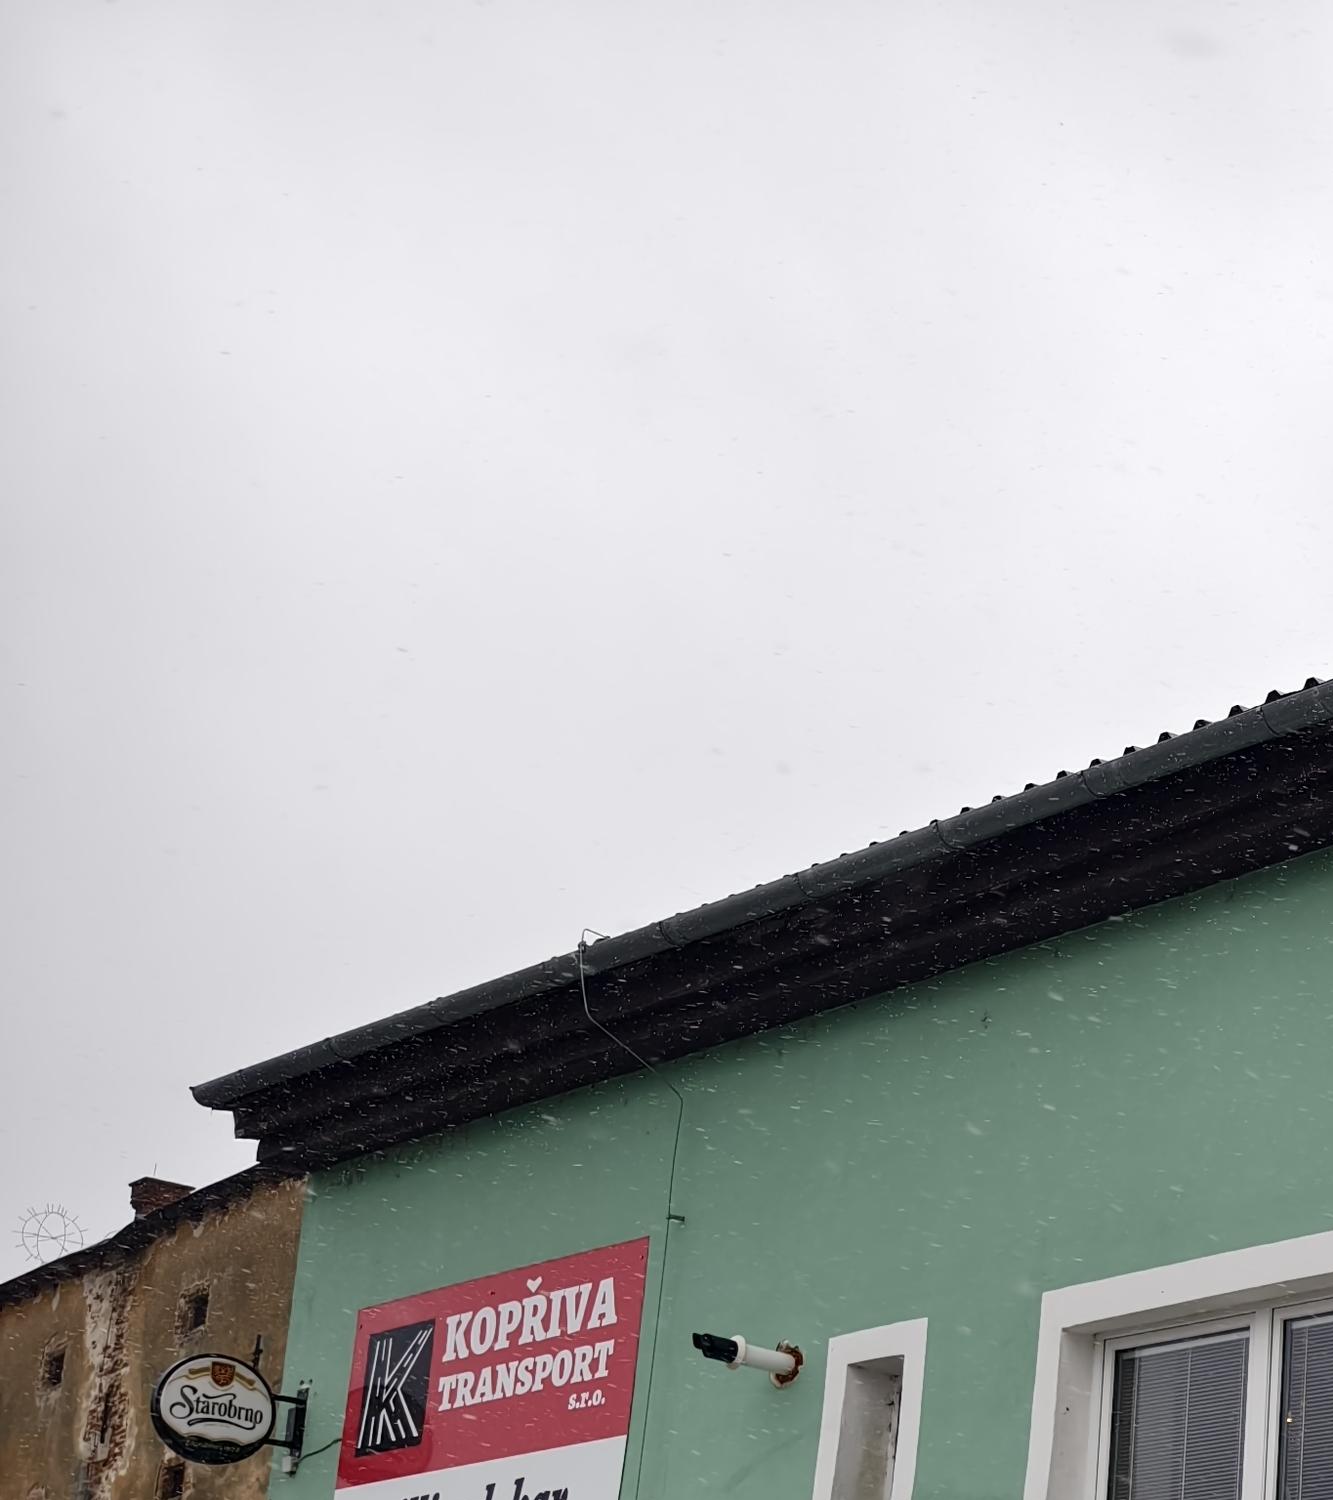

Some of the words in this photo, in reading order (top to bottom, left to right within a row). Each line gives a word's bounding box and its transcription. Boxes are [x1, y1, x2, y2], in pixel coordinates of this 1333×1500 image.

[442, 1276, 617, 1362] KOPŘIVA
[438, 1338, 615, 1411] TRANSPORT
[567, 1389, 605, 1410] s.r.o.
[169, 1384, 263, 1430] Starobrno
